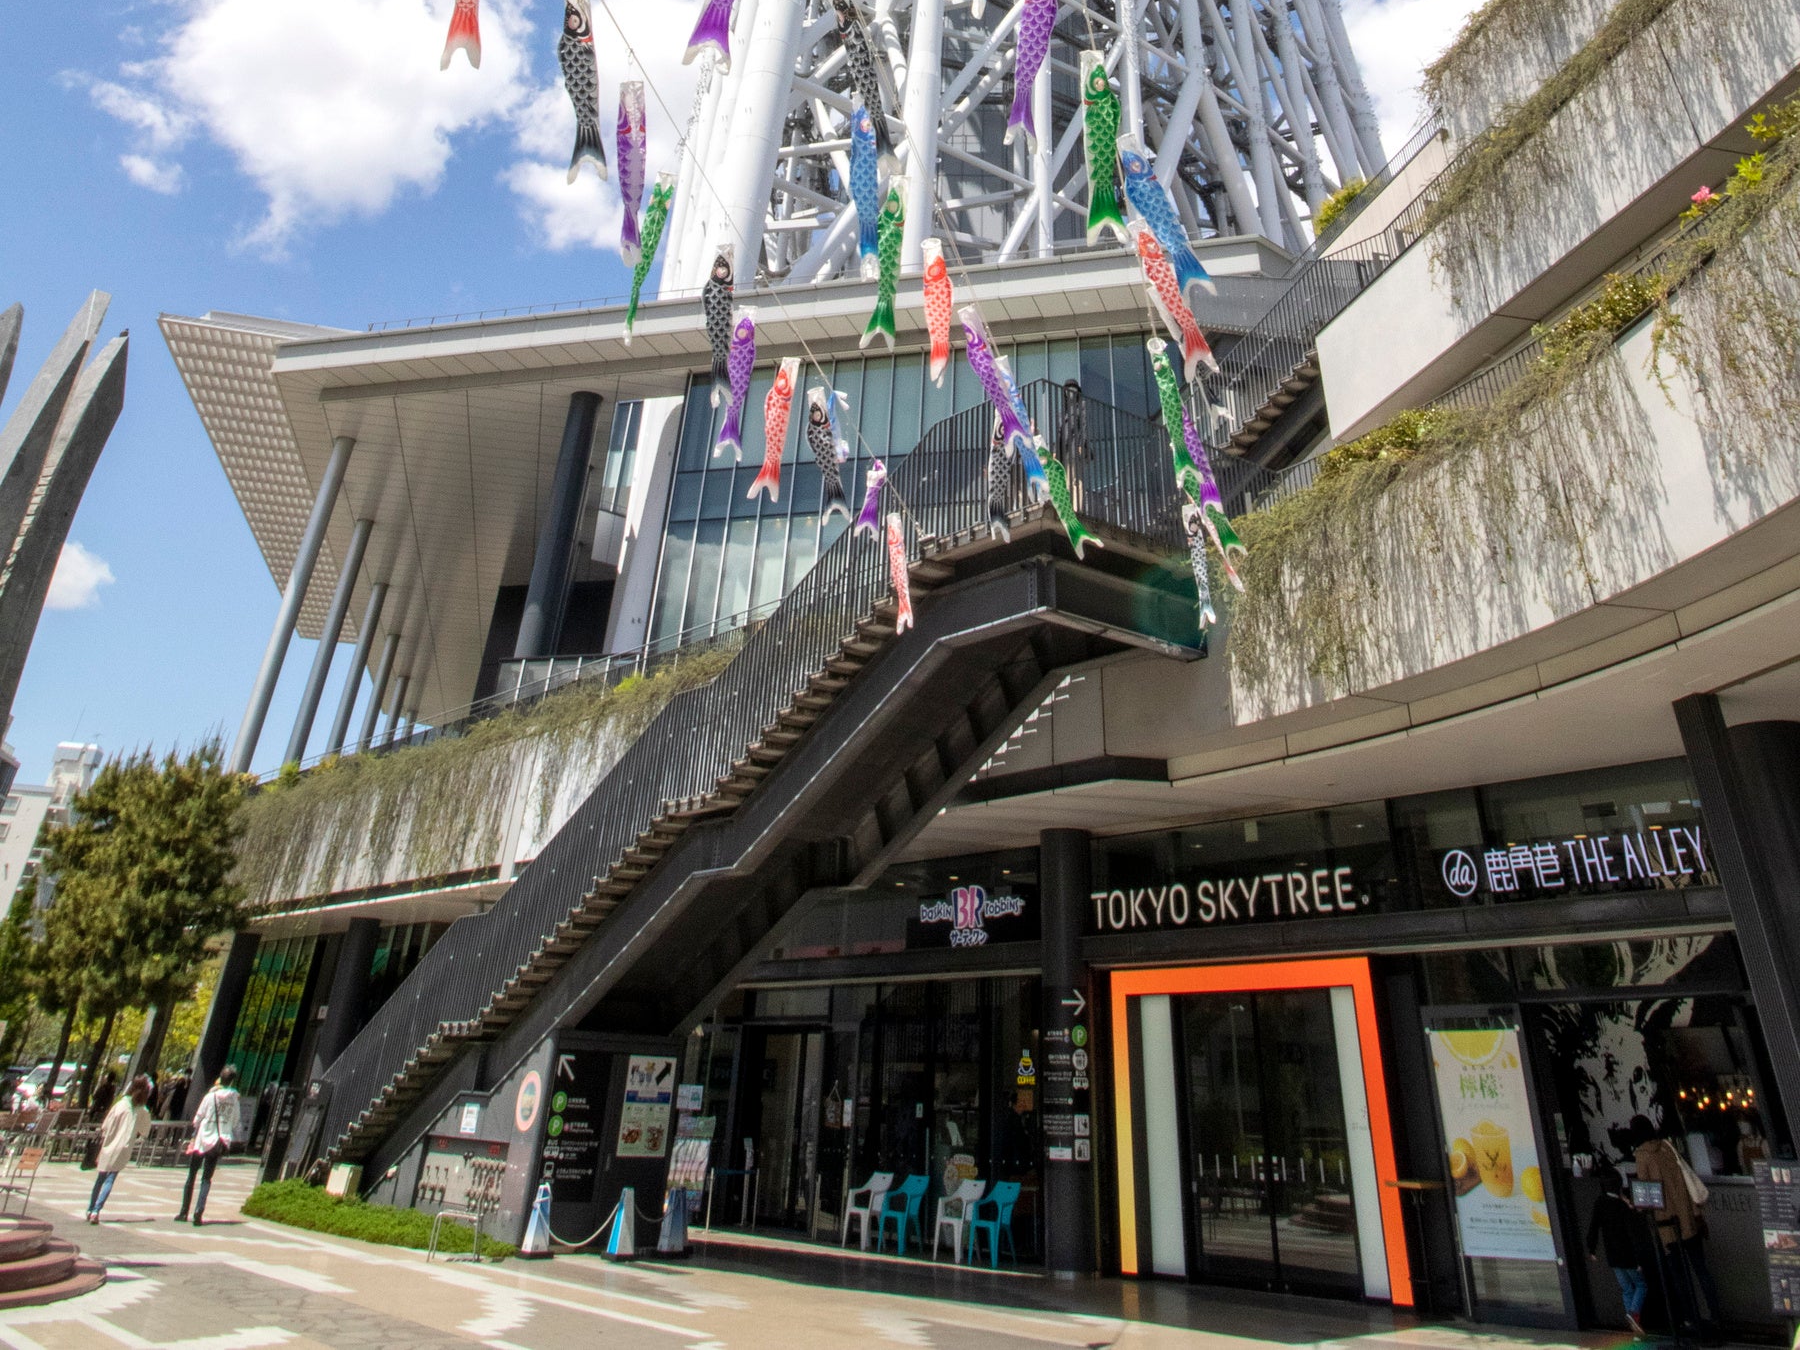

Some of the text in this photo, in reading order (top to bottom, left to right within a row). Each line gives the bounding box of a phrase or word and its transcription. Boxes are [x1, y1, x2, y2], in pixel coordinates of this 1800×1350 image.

[1484, 842, 1565, 892] 鹿角巷
[1563, 837, 1619, 885] THE
[1623, 826, 1707, 880] ALLEY
[920, 901, 953, 922] baskin
[1091, 884, 1189, 930] TOKYO
[950, 930, 988, 946] サーティワン
